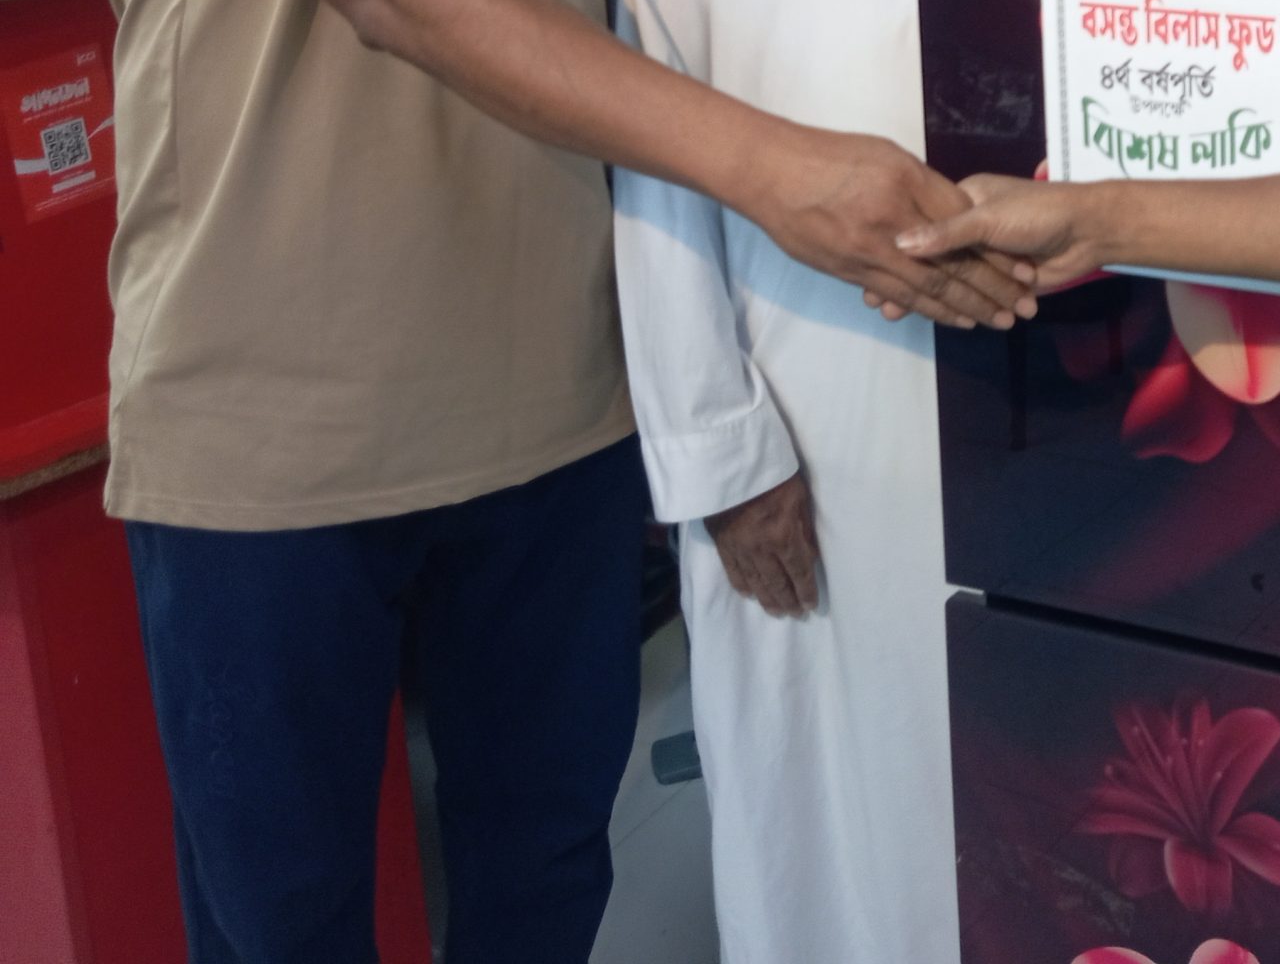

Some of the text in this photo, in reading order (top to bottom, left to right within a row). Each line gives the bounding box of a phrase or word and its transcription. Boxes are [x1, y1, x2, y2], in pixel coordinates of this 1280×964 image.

[1080, 2, 1138, 46] বসন্ত
[1226, 13, 1276, 71] ফুড
[1101, 58, 1216, 102] ৪র্থ বর্ষপূর্তি
[1129, 94, 1192, 119] উপলক্ষে
[1081, 96, 1181, 179] বিশেষ
[1190, 107, 1273, 168] লাকি
